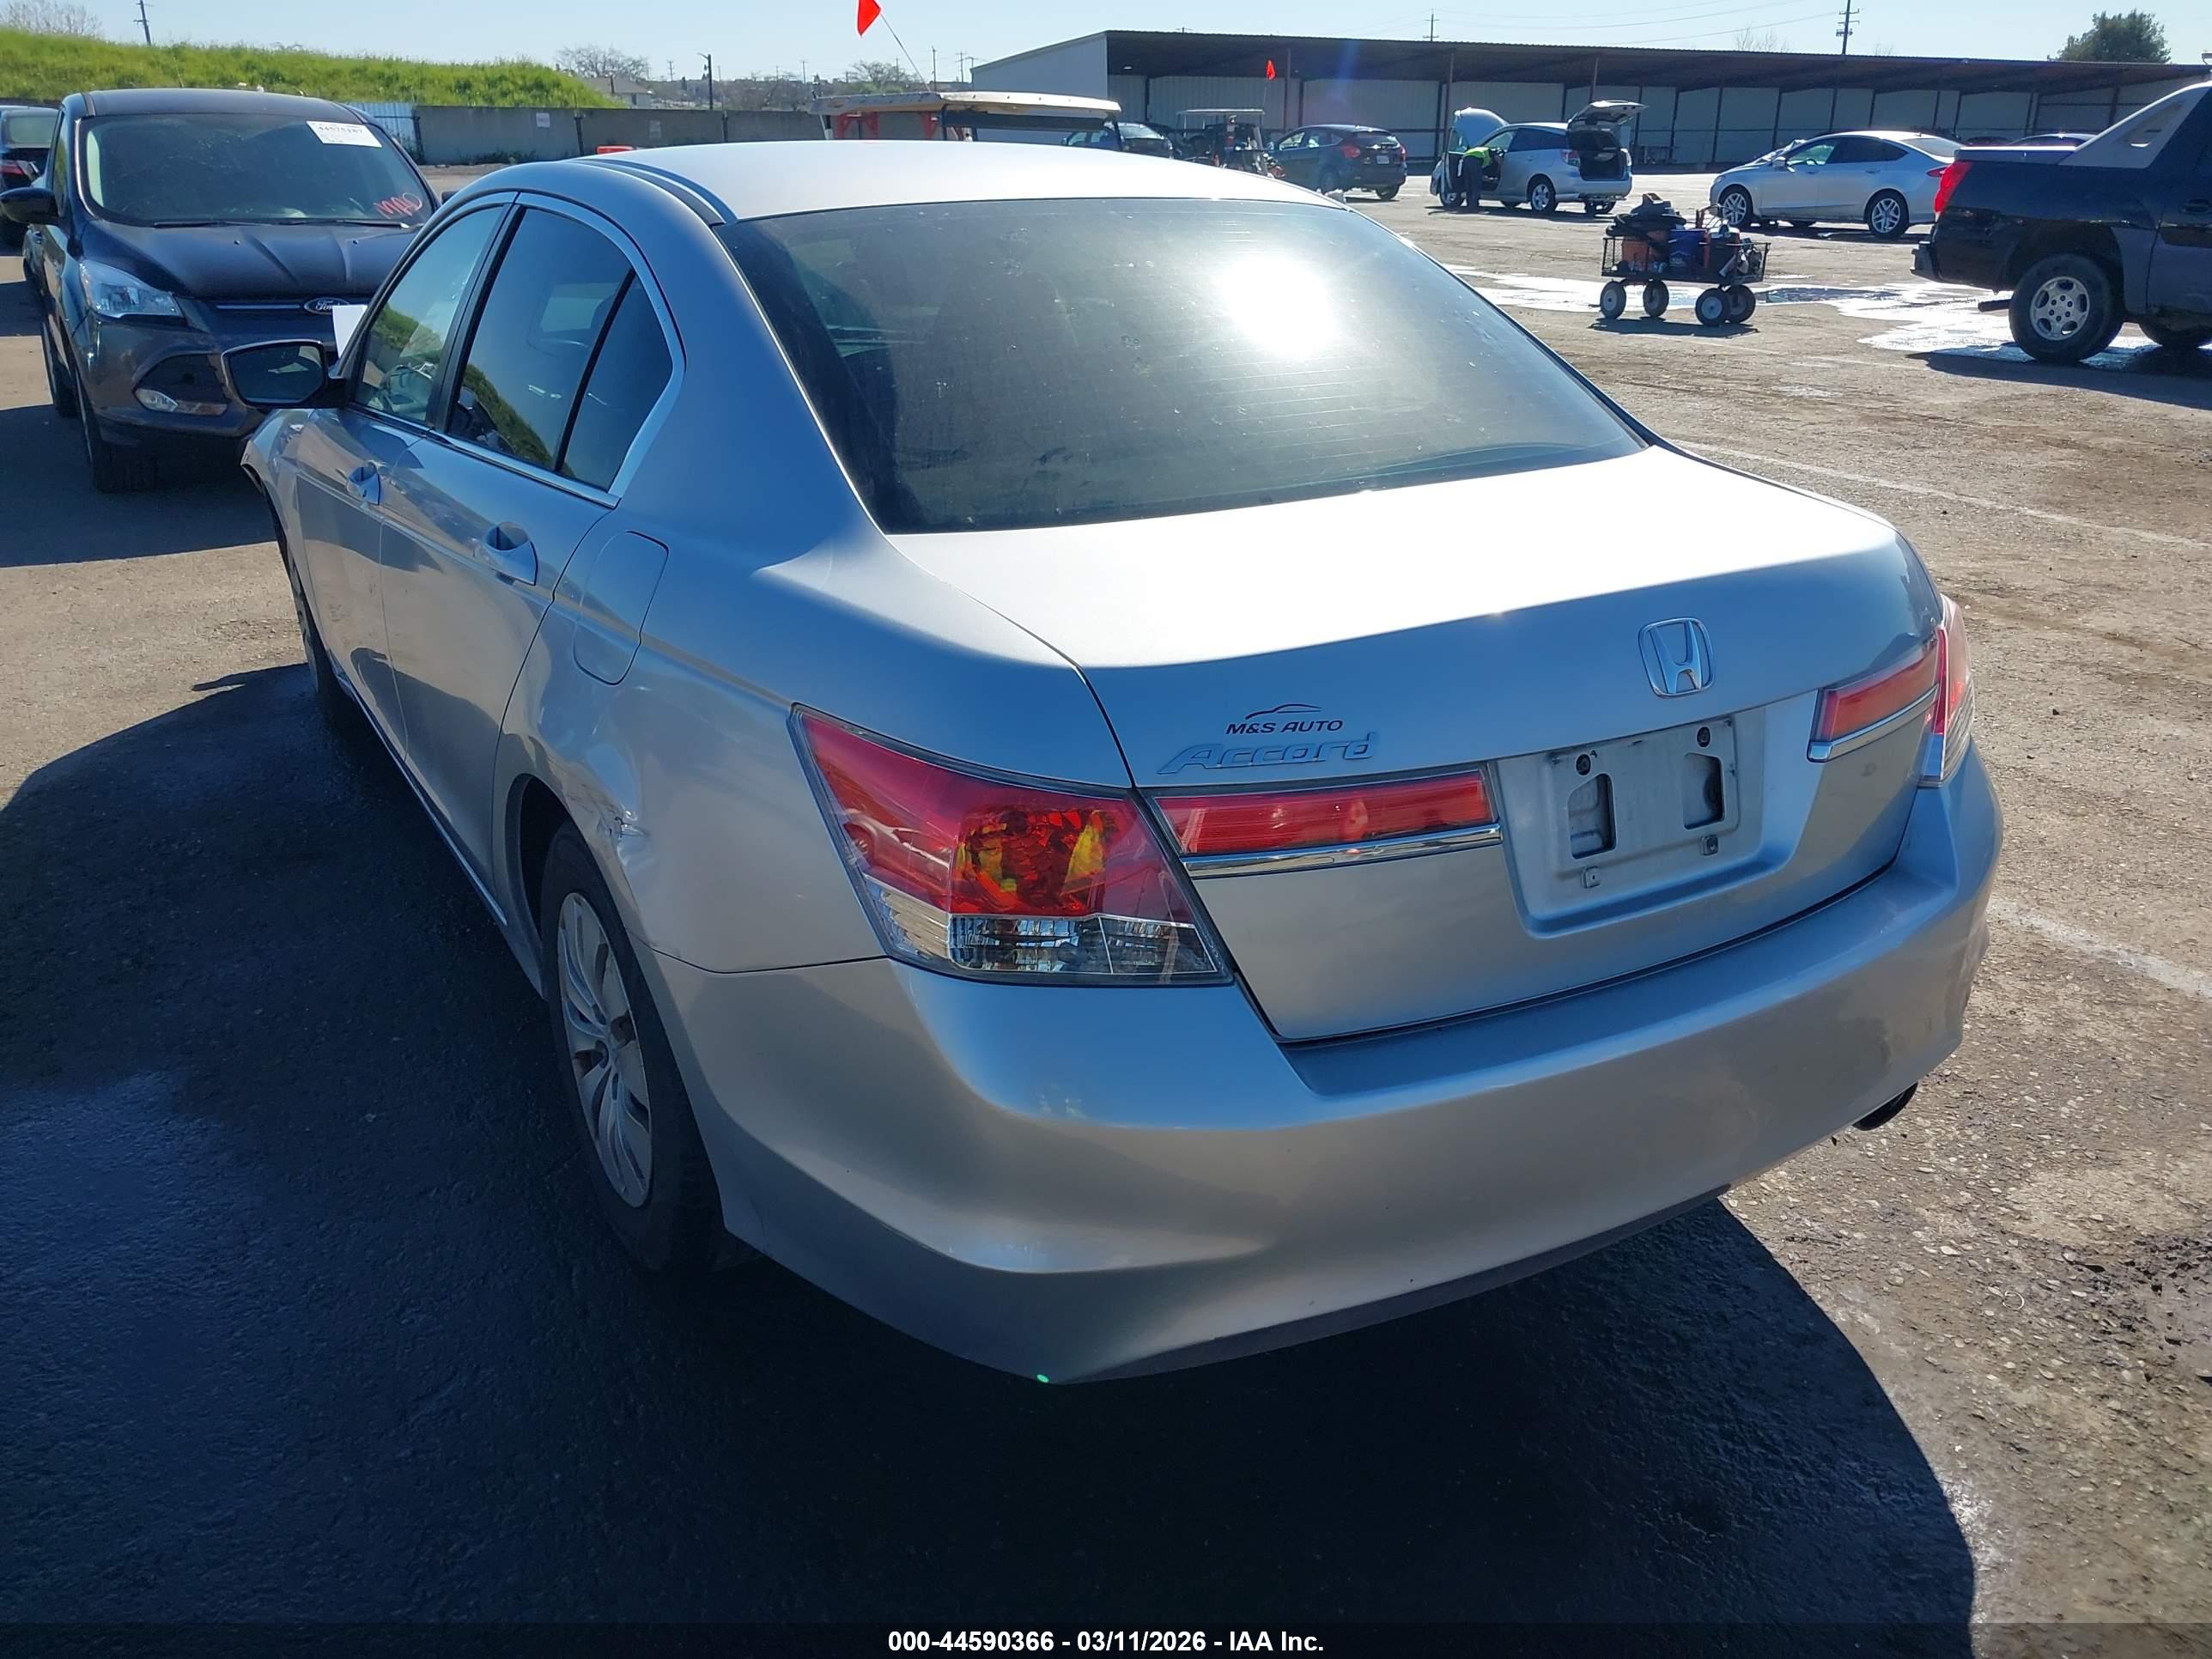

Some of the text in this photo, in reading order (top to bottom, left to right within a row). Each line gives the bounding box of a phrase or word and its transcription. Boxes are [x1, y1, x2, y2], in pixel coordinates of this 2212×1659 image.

[1225, 720, 1343, 735] M&S AUTO
[1157, 732, 1377, 775] Accord
